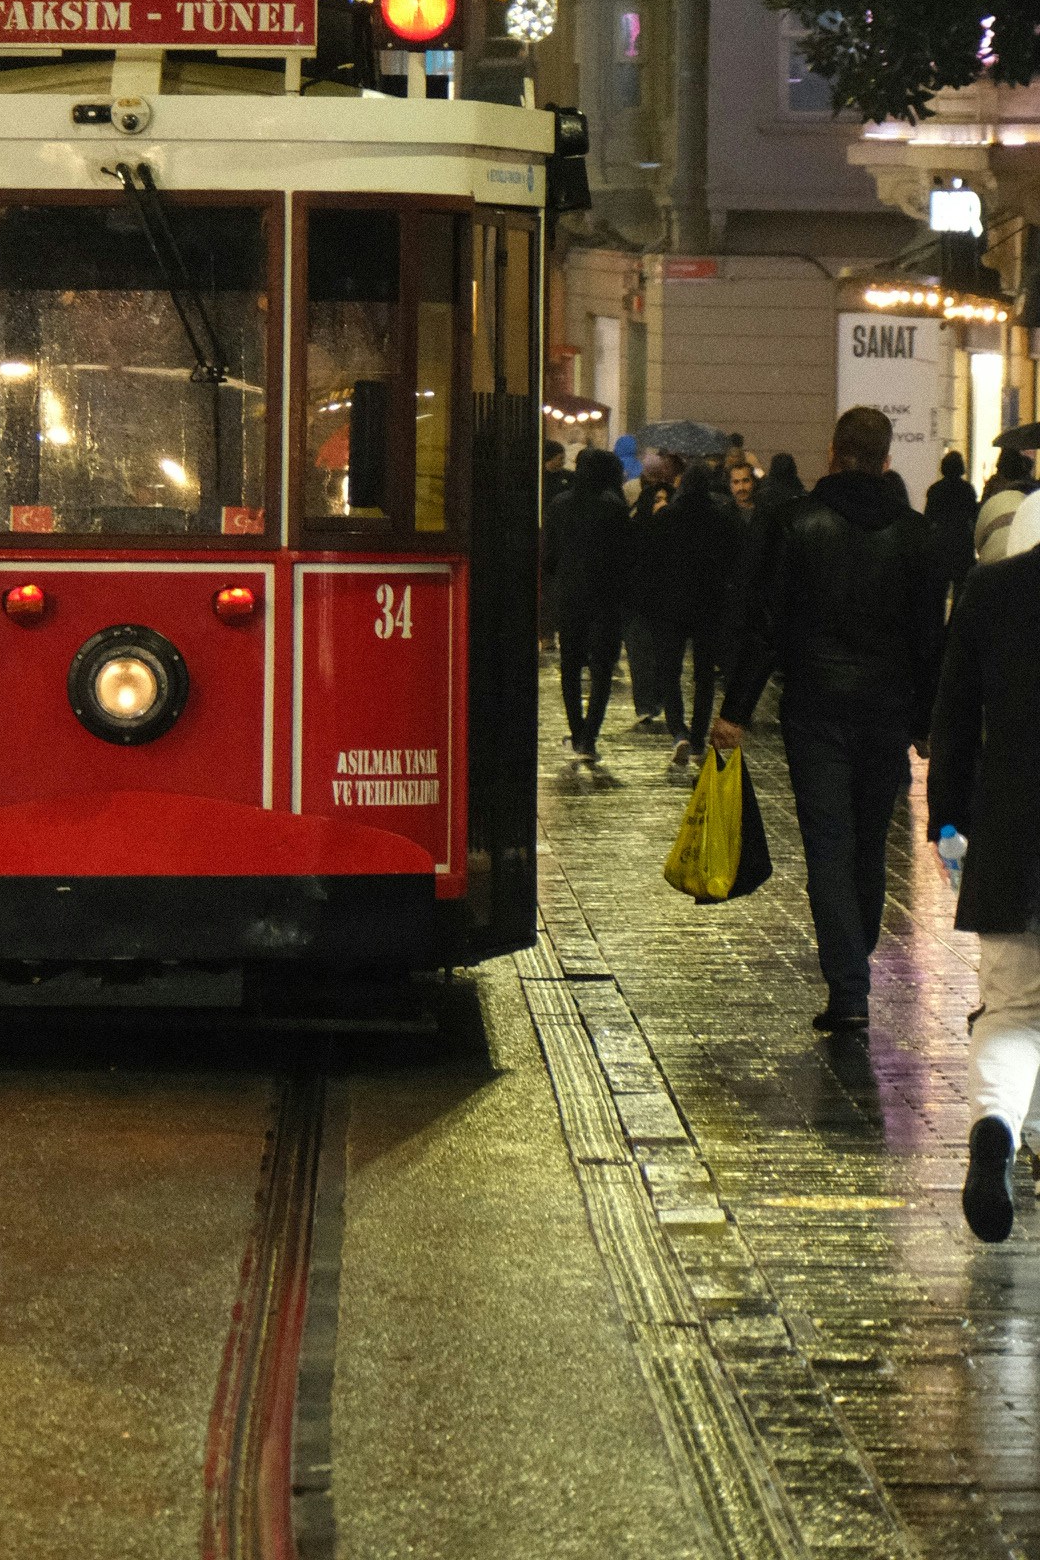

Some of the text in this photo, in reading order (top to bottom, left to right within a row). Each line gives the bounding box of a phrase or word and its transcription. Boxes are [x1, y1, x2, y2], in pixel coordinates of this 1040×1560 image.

[852, 324, 917, 359] SANAT
[374, 583, 413, 639] 34
[337, 749, 438, 775] ASILMAK YASAK
[332, 780, 352, 807] VE
